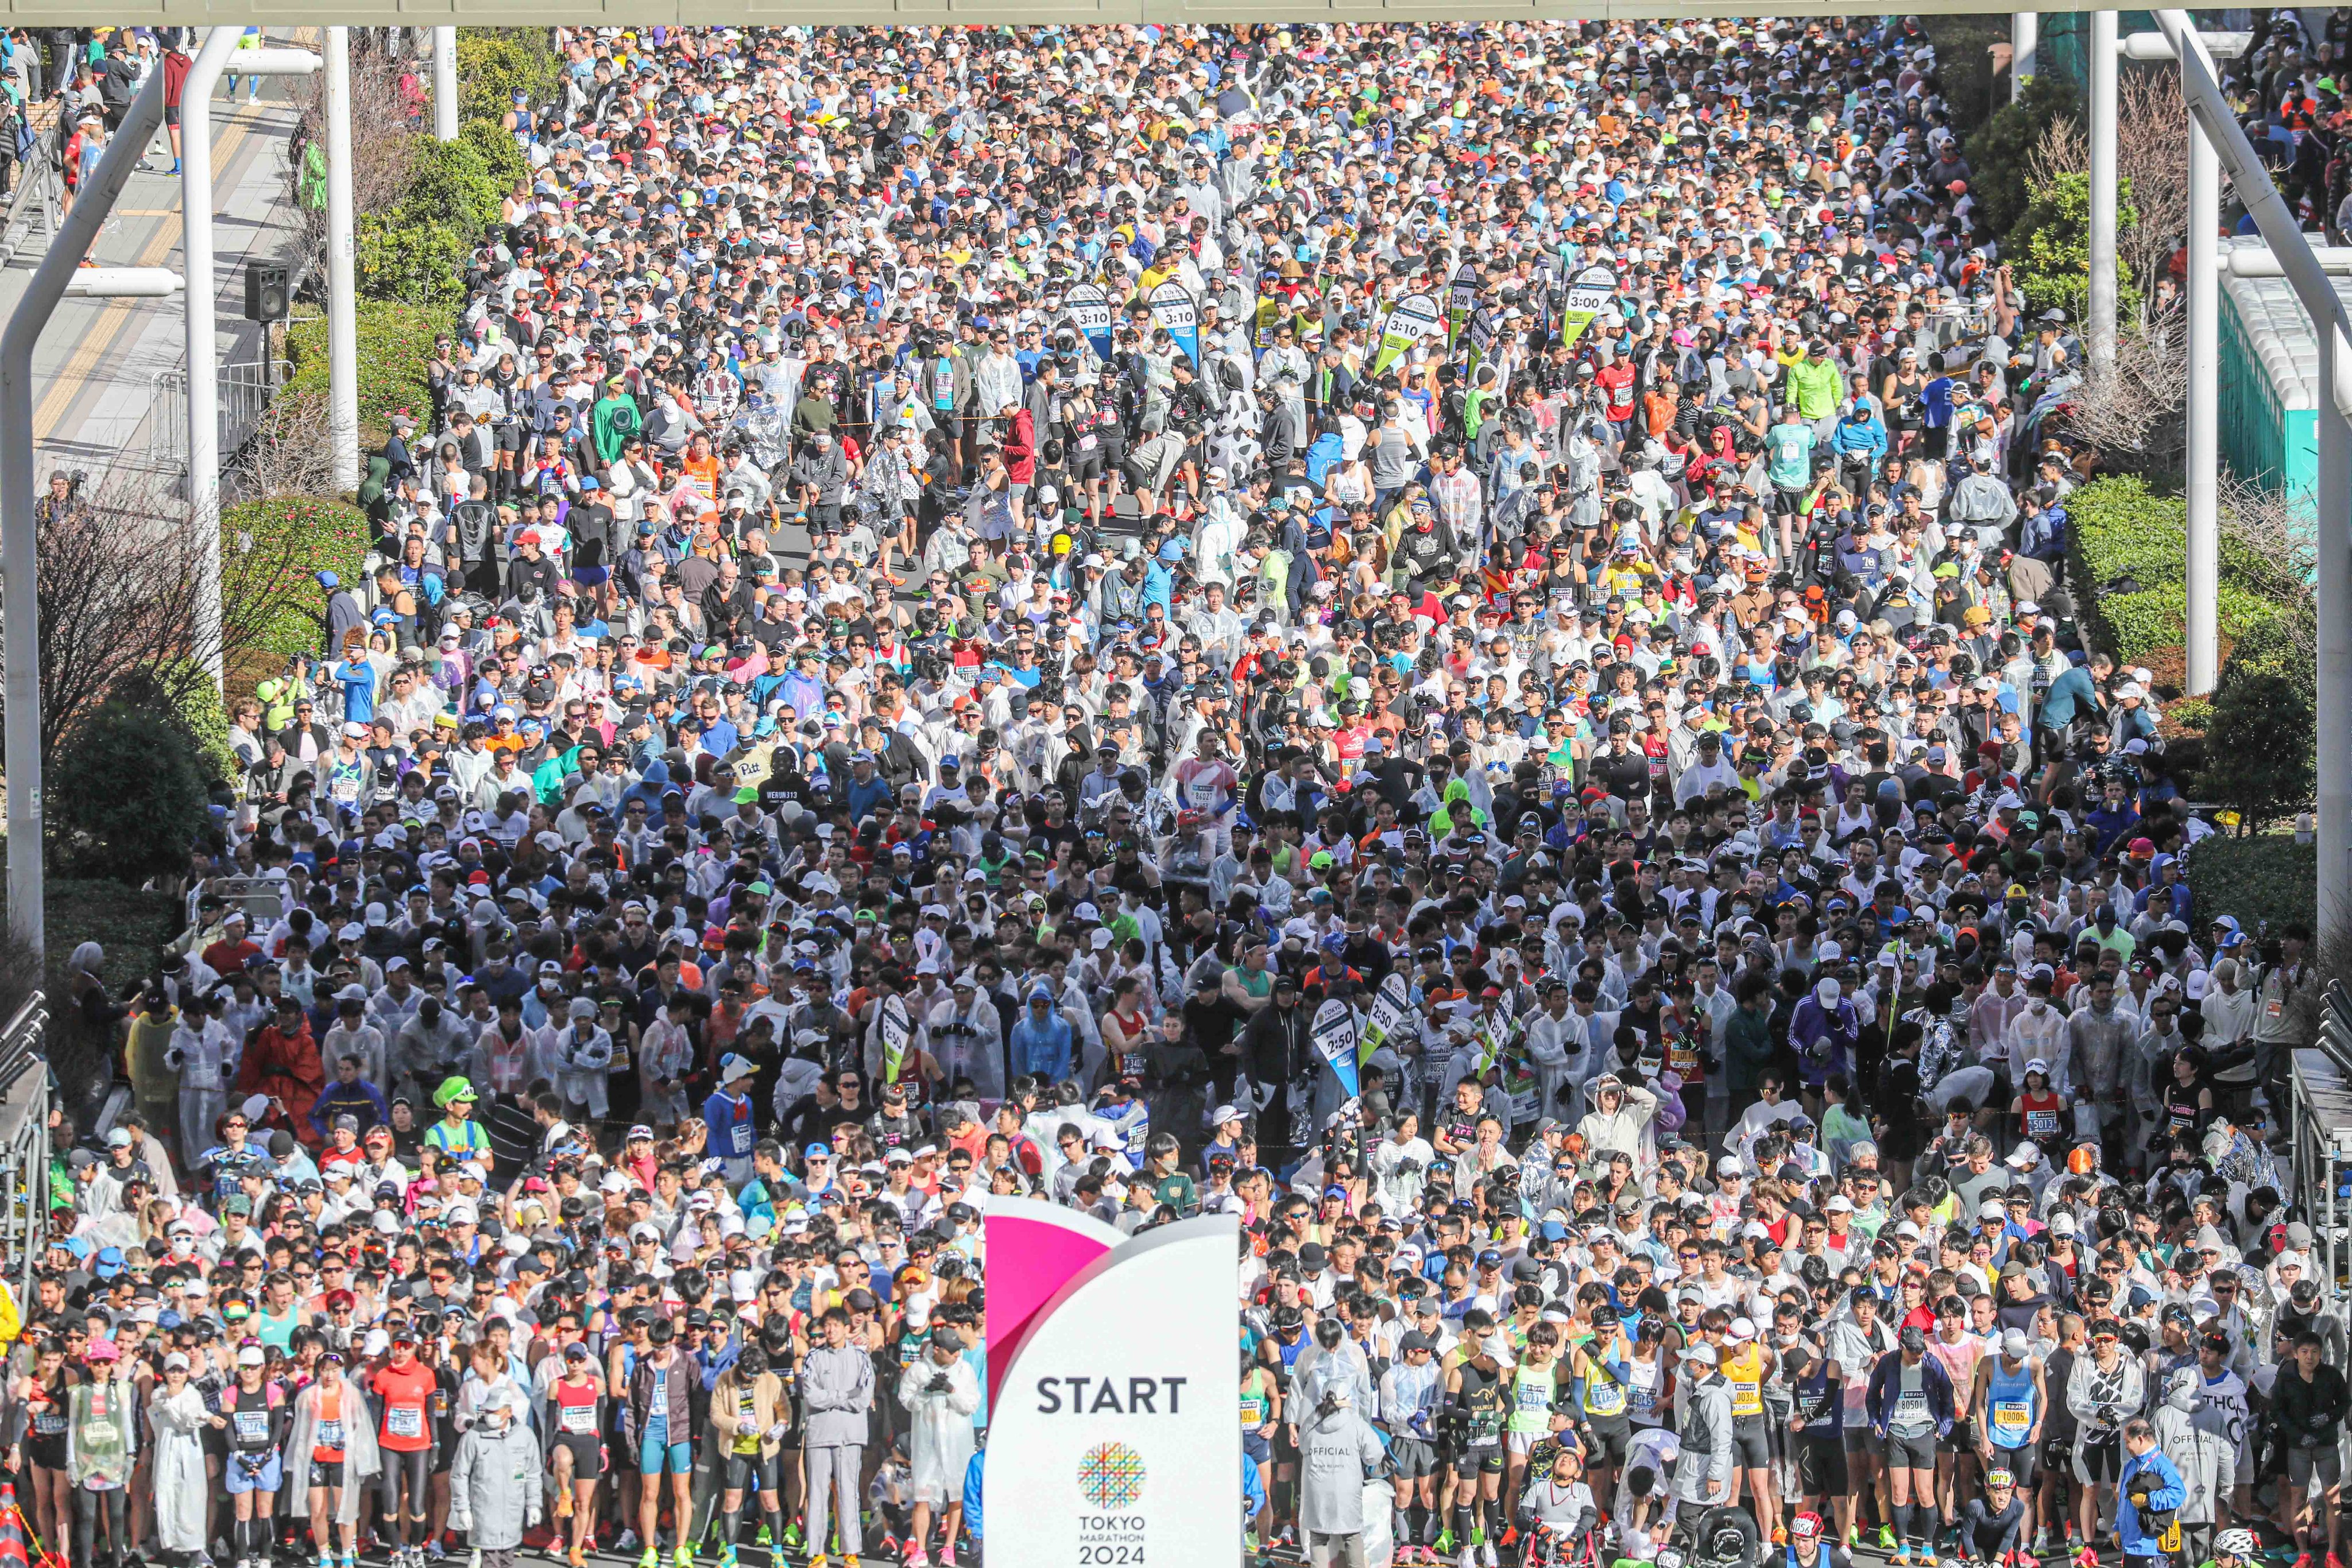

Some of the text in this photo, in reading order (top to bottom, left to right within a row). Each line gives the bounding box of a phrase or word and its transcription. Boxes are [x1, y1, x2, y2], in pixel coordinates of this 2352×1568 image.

[1453, 294, 1468, 306] 3:00
[1570, 297, 1599, 308] 3:00
[1415, 301, 1433, 311] TOKYO
[1080, 313, 1108, 324] 3:10
[1166, 312, 1193, 324] 3:10
[1390, 320, 1418, 336] 3:10
[738, 762, 761, 776] Pitt
[1196, 793, 1213, 801] 86027
[1324, 1004, 1342, 1016] TOKYO
[1372, 1004, 1391, 1029] 2:50
[1328, 1031, 1353, 1055] 2:50
[2033, 1120, 2053, 1129] 5013
[1037, 1377, 1187, 1415] START
[1522, 1391, 1542, 1404] 4037
[1598, 1393, 1618, 1404] 4155
[1634, 1395, 1653, 1406] 4045
[1736, 1392, 1754, 1401] 0032
[1901, 1400, 1922, 1410] 80501
[2003, 1412, 2025, 1422] 10005
[2173, 1435, 2213, 1445] OFFICIAL
[1079, 1516, 1146, 1531] TOKYO
[1792, 1522, 1811, 1535] 1056
[1080, 1534, 1145, 1543] MARATHON
[1079, 1546, 1146, 1566] 2024
